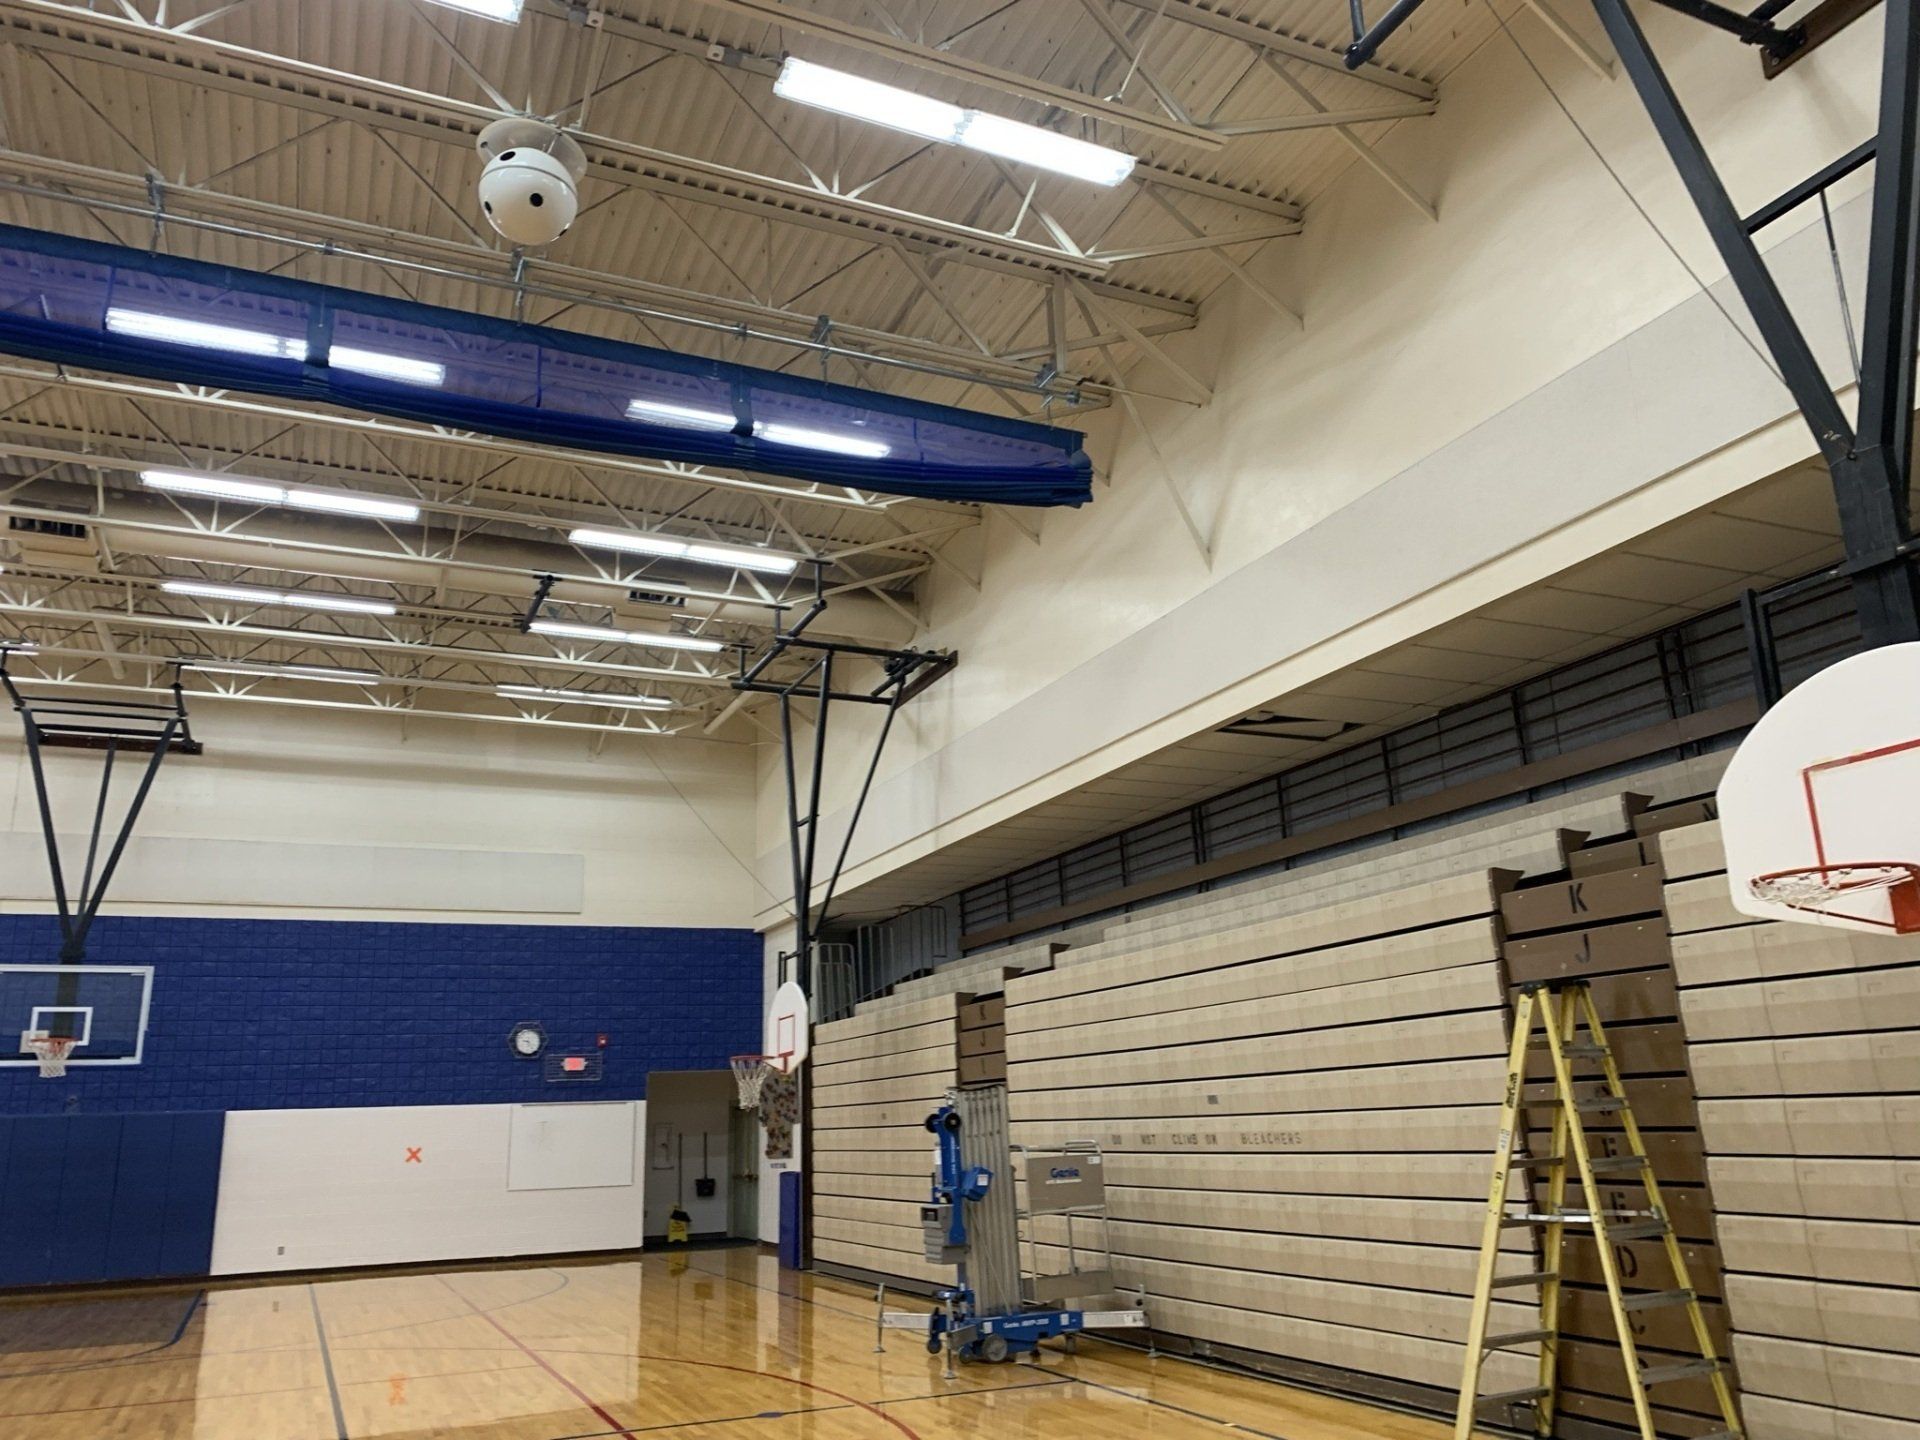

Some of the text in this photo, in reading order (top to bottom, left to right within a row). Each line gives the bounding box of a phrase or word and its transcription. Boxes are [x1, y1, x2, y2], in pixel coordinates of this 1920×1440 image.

[1569, 882, 1588, 914] K
[1575, 933, 1591, 964] J
[1140, 1133, 1156, 1145] NOT
[1171, 1133, 1199, 1145] CLIMB
[1205, 1133, 1218, 1145] ON
[1241, 1131, 1302, 1145] BLEACHERS
[1615, 1244, 1638, 1278] D
